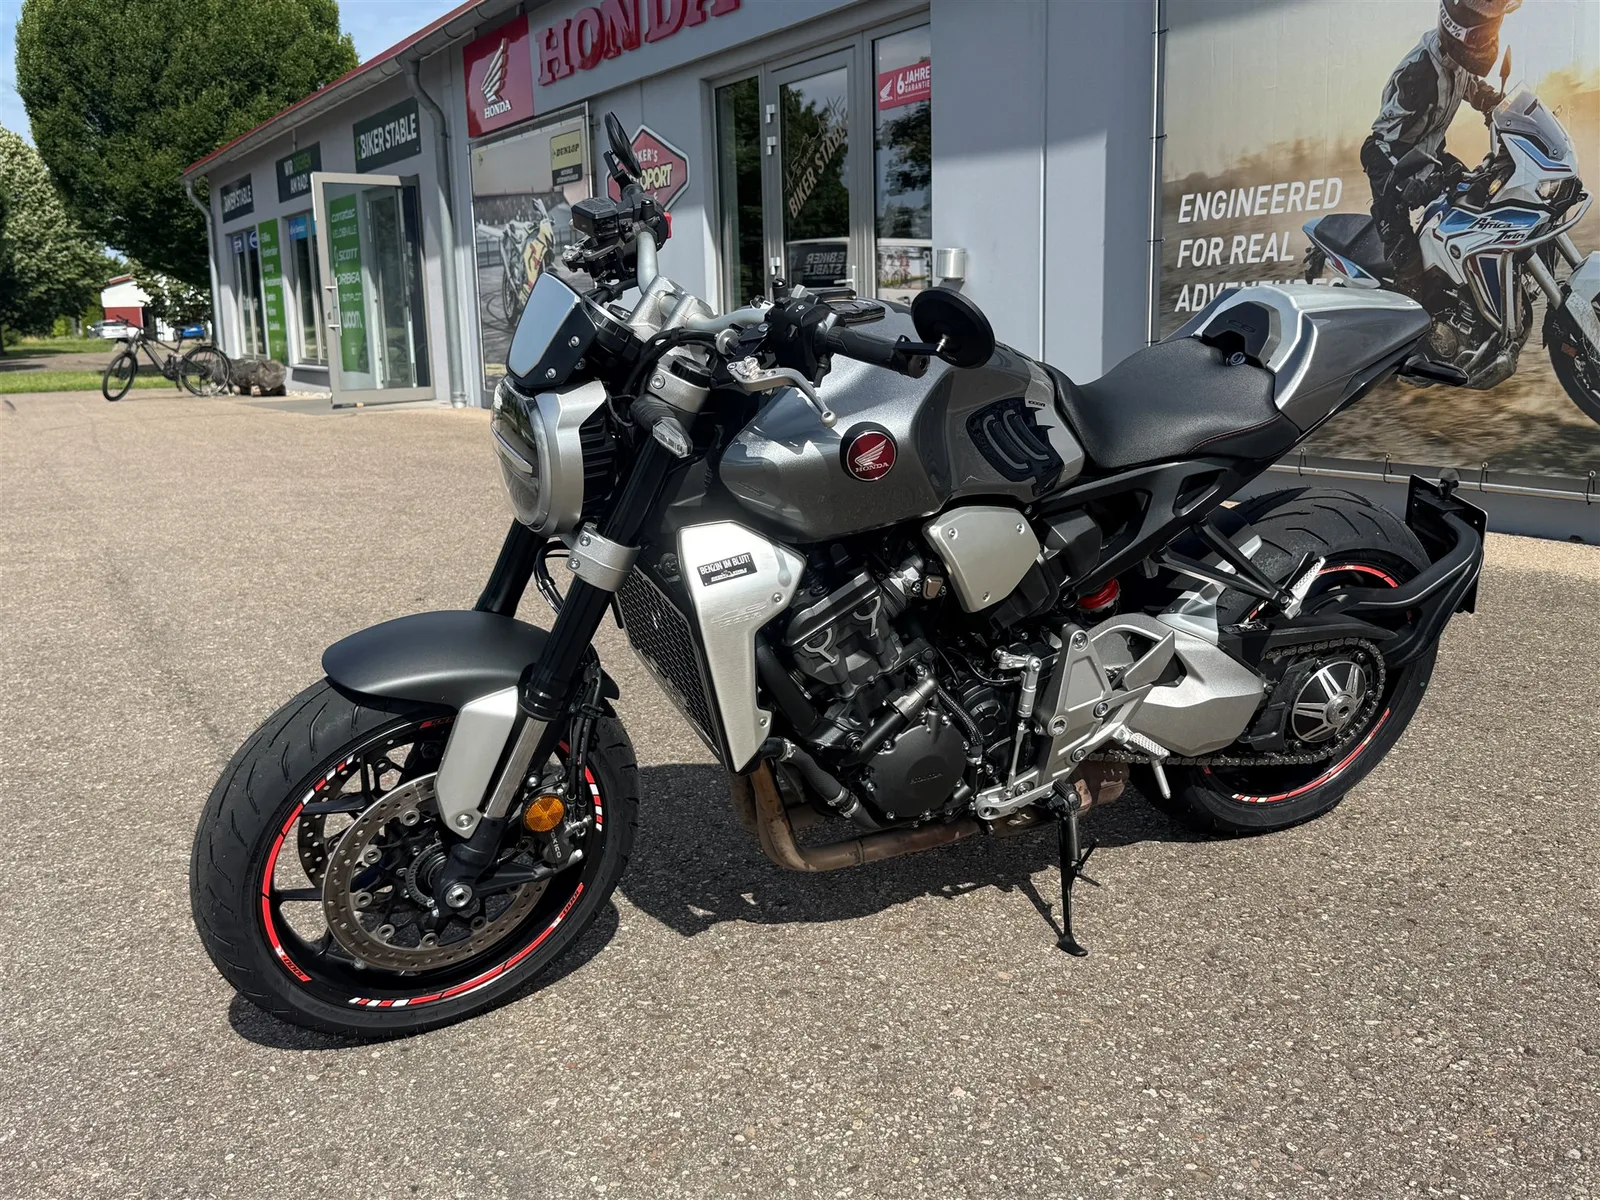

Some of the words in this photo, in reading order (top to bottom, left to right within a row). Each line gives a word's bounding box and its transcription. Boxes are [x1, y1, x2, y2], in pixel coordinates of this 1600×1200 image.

[905, 65, 931, 84] JAHRE
[484, 99, 512, 119] HONDA
[385, 112, 417, 149] STABLE
[556, 143, 580, 157] DUNLOP
[788, 166, 818, 219] BIKER
[1178, 177, 1343, 223] ENGINEERED
[1467, 217, 1514, 230] Africa
[1491, 229, 1527, 244] Twin
[338, 248, 358, 261] SCOTT
[1177, 237, 1224, 268] FOR
[1229, 231, 1294, 265] REAL
[336, 272, 361, 285] ORBEA
[855, 462, 889, 473] HONDA
[700, 561, 723, 575] BENZIN
[722, 559, 732, 569] IM
